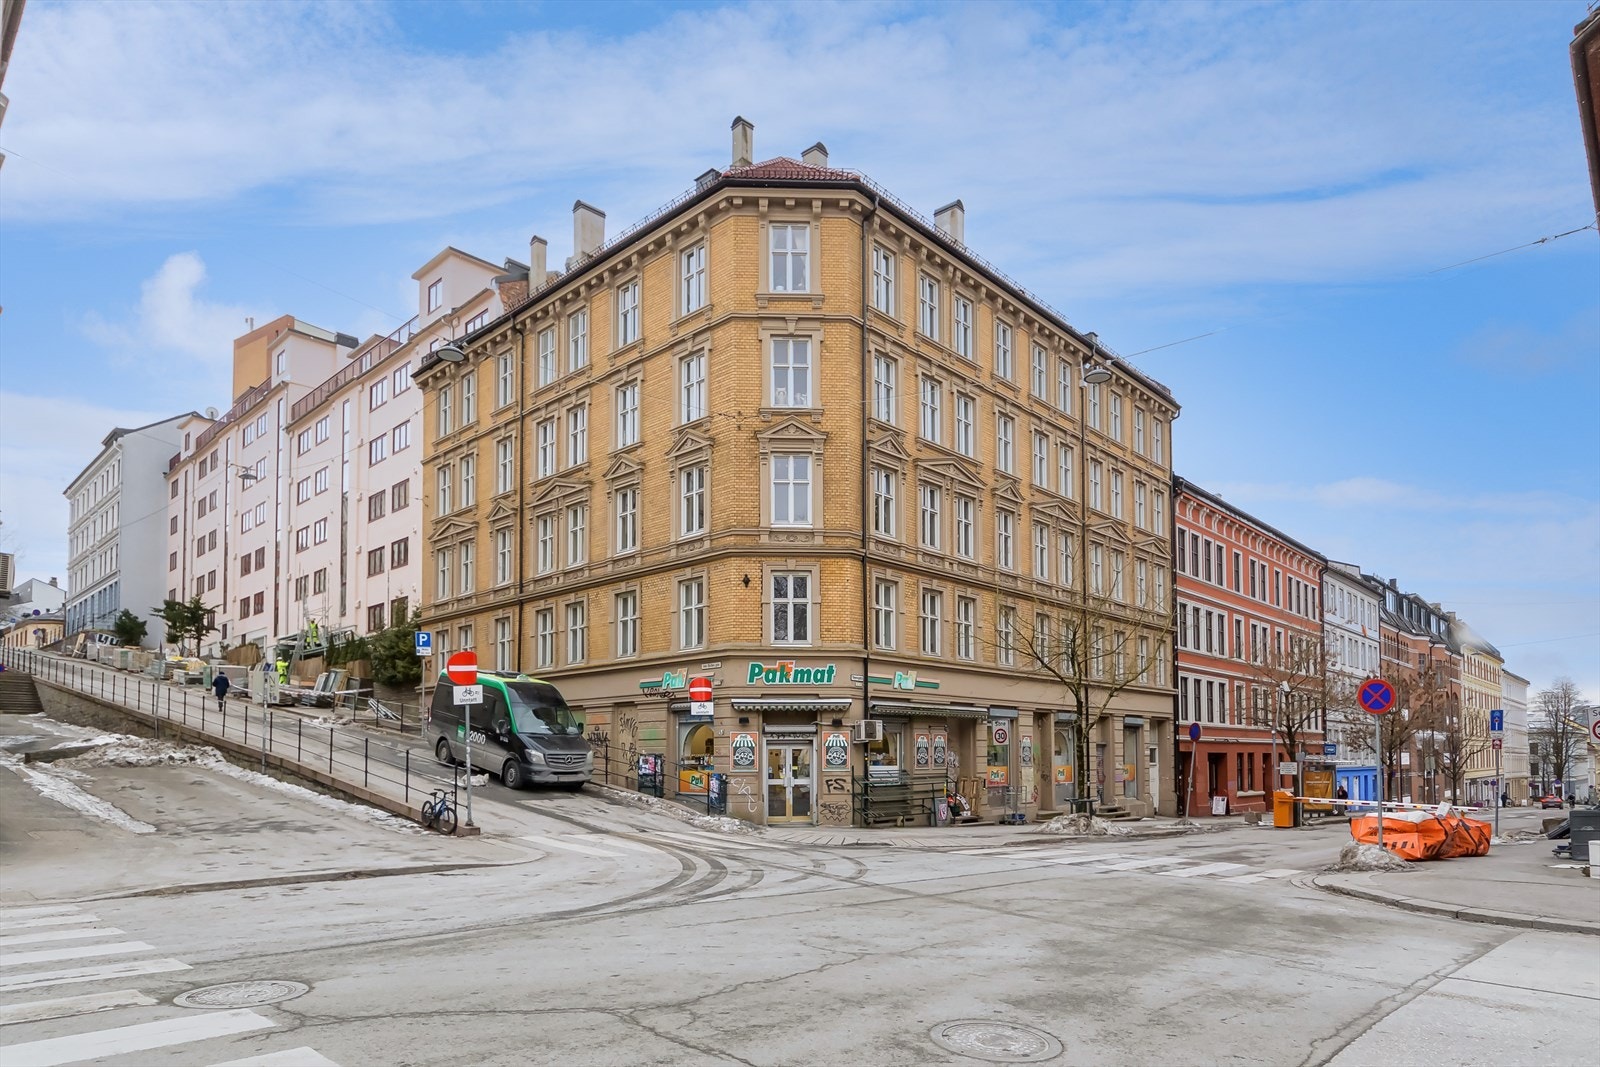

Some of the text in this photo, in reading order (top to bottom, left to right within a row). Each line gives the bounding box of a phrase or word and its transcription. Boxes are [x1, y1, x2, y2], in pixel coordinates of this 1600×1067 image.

[419, 633, 428, 646] P
[747, 661, 836, 685] Pakmat
[996, 732, 1005, 740] 30
